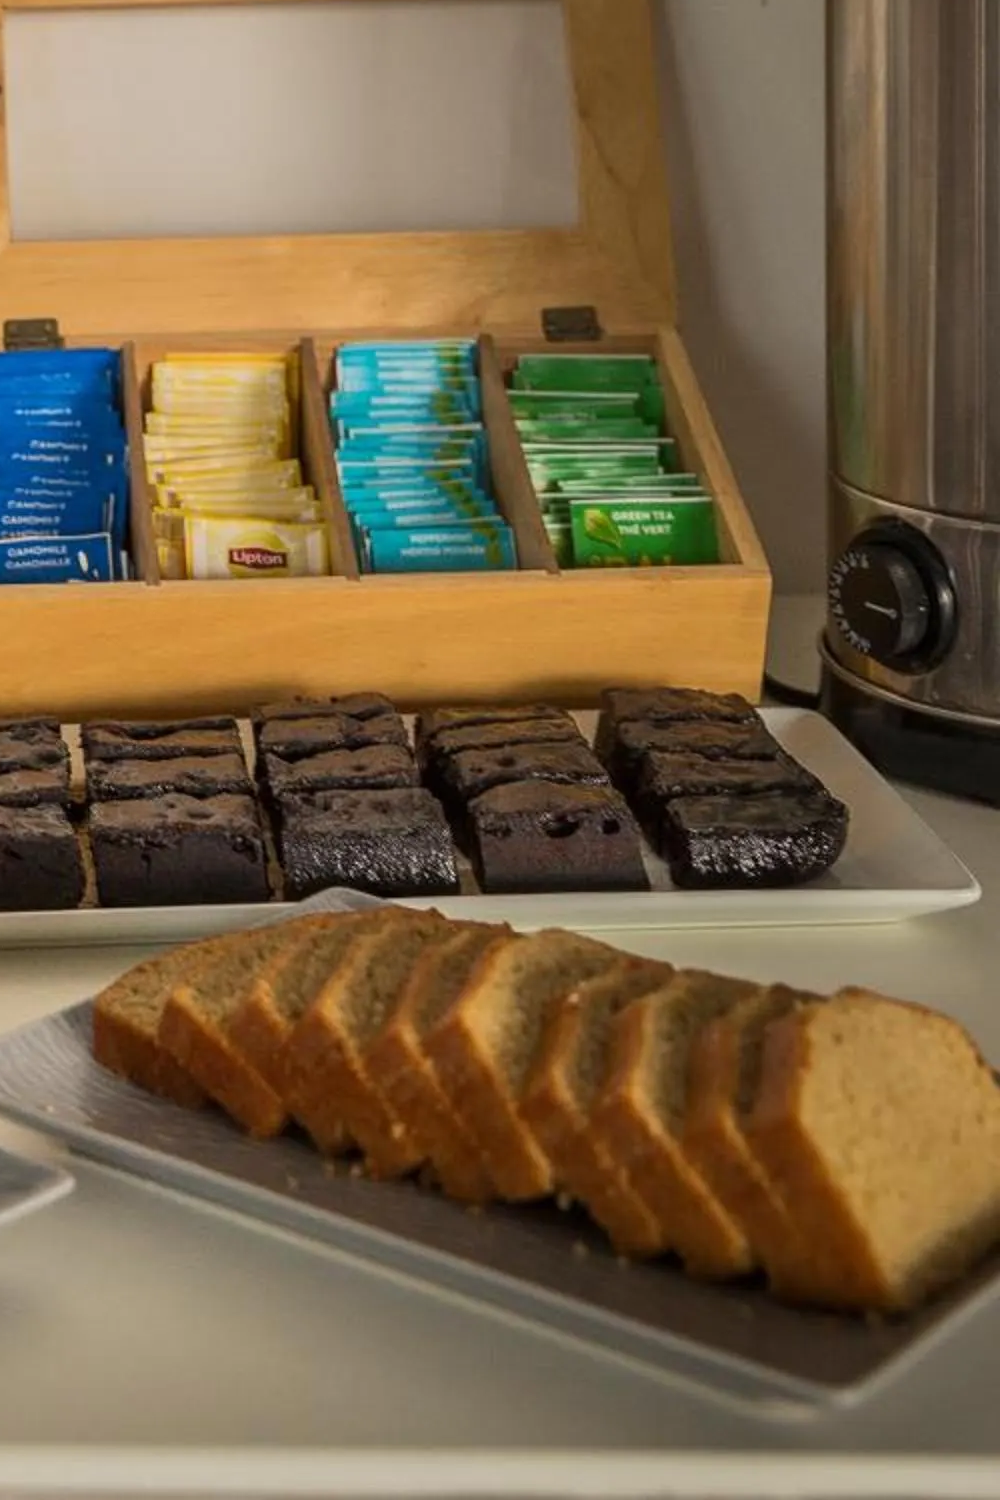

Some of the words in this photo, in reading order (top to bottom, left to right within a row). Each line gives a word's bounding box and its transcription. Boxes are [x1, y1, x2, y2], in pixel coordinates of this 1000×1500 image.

[611, 510, 651, 521] GREEN
[652, 510, 675, 521] TEA
[641, 523, 672, 535] VERT
[7, 545, 67, 558] CAMOMILE
[232, 550, 283, 565] Lipton
